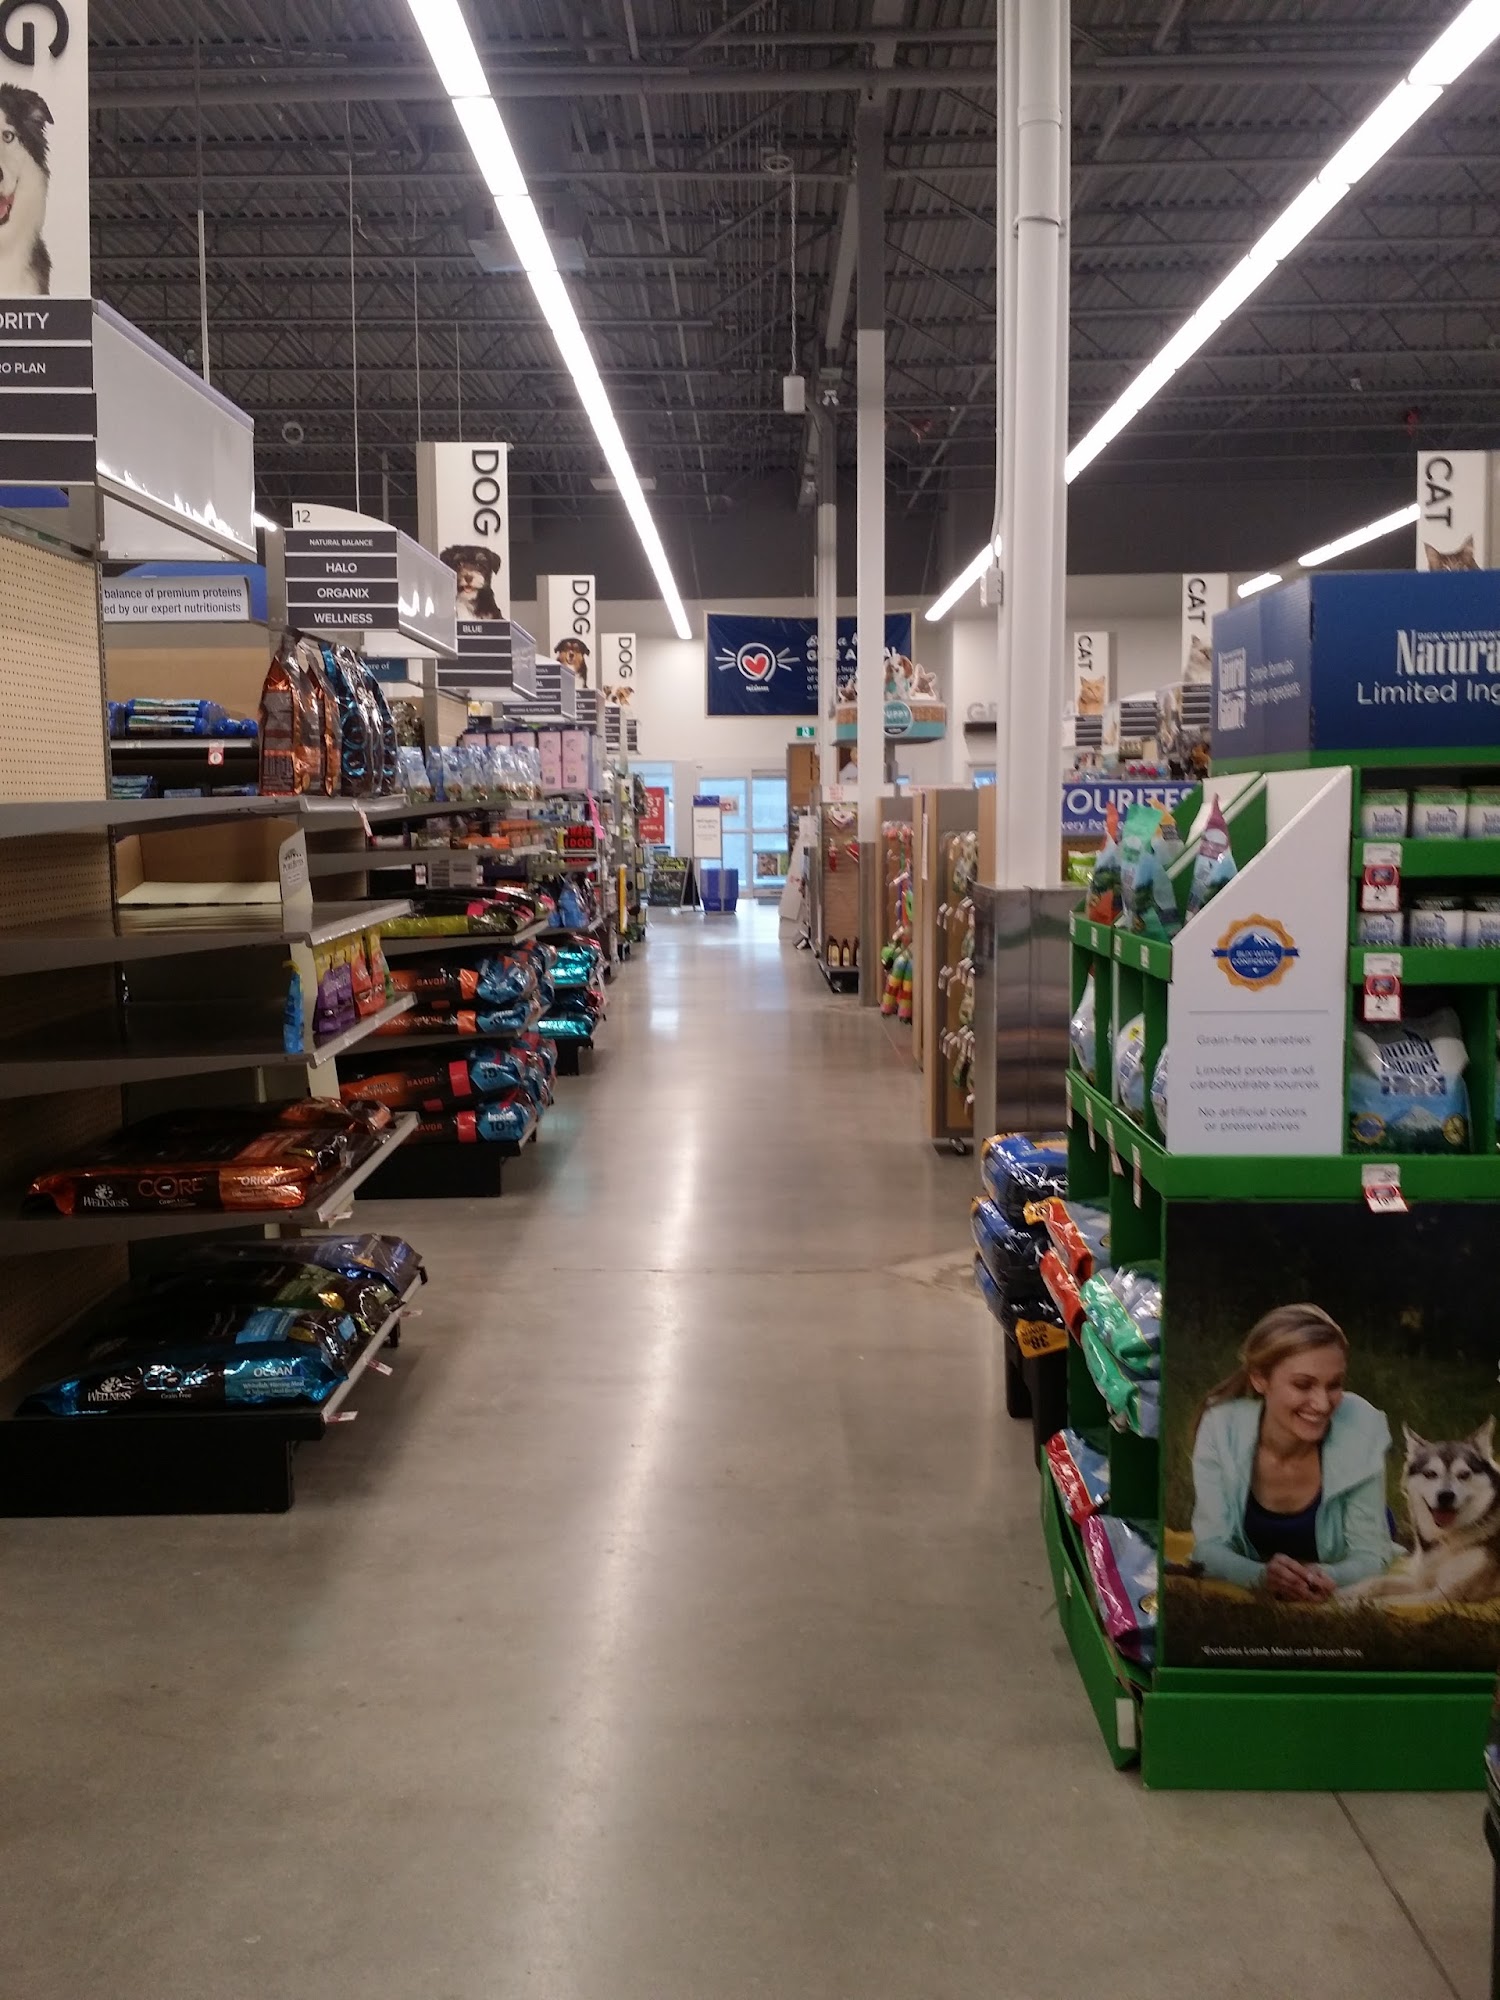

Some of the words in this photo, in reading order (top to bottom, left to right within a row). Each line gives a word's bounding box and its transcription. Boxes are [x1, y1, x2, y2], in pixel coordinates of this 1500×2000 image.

[0, 312, 49, 330] RITY
[0, 362, 12, 374] O
[14, 362, 46, 374] PLAN
[472, 450, 501, 536] DOG
[1425, 456, 1453, 527] CAT
[294, 509, 311, 523] 12
[309, 538, 340, 546] NATURAL
[341, 538, 373, 547] BALANCE
[325, 562, 358, 573] HALO
[104, 588, 142, 599] balance
[145, 588, 155, 598] of
[157, 588, 200, 600] premium
[202, 588, 242, 600] proteins
[316, 588, 369, 599] ORGANIX
[572, 580, 591, 636] DOG
[1187, 578, 1207, 625] CAT
[104, 605, 116, 615] ed
[118, 604, 130, 616] by
[132, 606, 148, 614] our
[151, 604, 181, 616] expert
[184, 603, 241, 614] nutritionists
[313, 613, 373, 624] WELLNESS
[462, 624, 483, 634] BLUE
[618, 637, 634, 679] DOG
[1077, 634, 1093, 671] CAT
[1358, 678, 1458, 705] Limited
[1466, 678, 1500, 706] Ing
[1197, 1034, 1257, 1045] Grain-free
[1196, 1065, 1241, 1076] Limited
[1244, 1065, 1288, 1078] protein
[1291, 1065, 1314, 1075] and
[406, 1075, 436, 1088] SAVOR
[1190, 1080, 1270, 1092] carbohydrate
[1273, 1080, 1320, 1090] sources
[1198, 1106, 1215, 1117] No
[1219, 1106, 1267, 1117] artificial
[1220, 1121, 1300, 1132] preservatives
[138, 1176, 203, 1198] CORE
[83, 1196, 129, 1208] WELLNESS
[253, 1365, 293, 1378] OCEAN
[88, 1390, 131, 1402] WELLNESS
